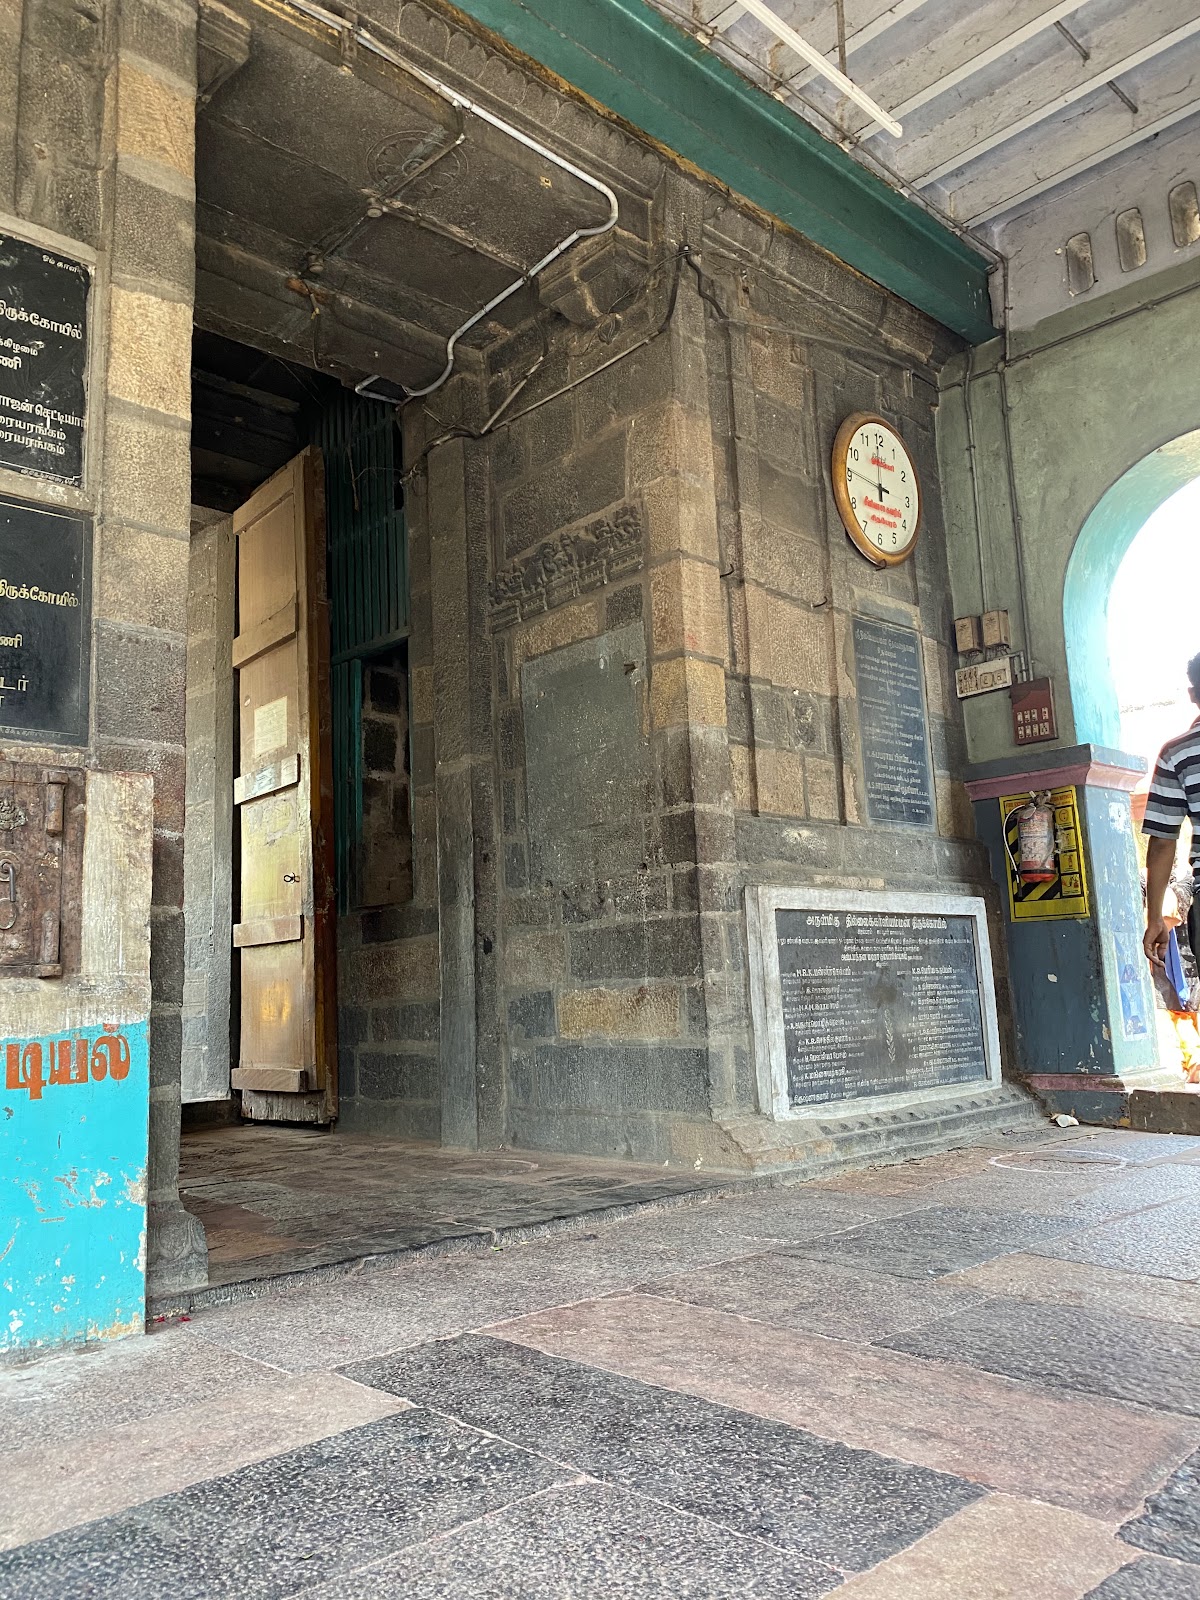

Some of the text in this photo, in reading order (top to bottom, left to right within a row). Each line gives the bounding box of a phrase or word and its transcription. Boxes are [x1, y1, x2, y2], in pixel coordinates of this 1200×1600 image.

[860, 432, 869, 447] 11
[874, 433, 884, 447] 12
[849, 447, 859, 461] 10
[891, 448, 896, 460] 1
[846, 468, 853, 482] 9
[901, 471, 906, 483] 2
[851, 497, 857, 509] 8
[905, 496, 910, 508] 3
[862, 519, 868, 532] 7
[902, 519, 907, 531] 4
[877, 533, 883, 545] 6
[892, 532, 897, 544] 5
